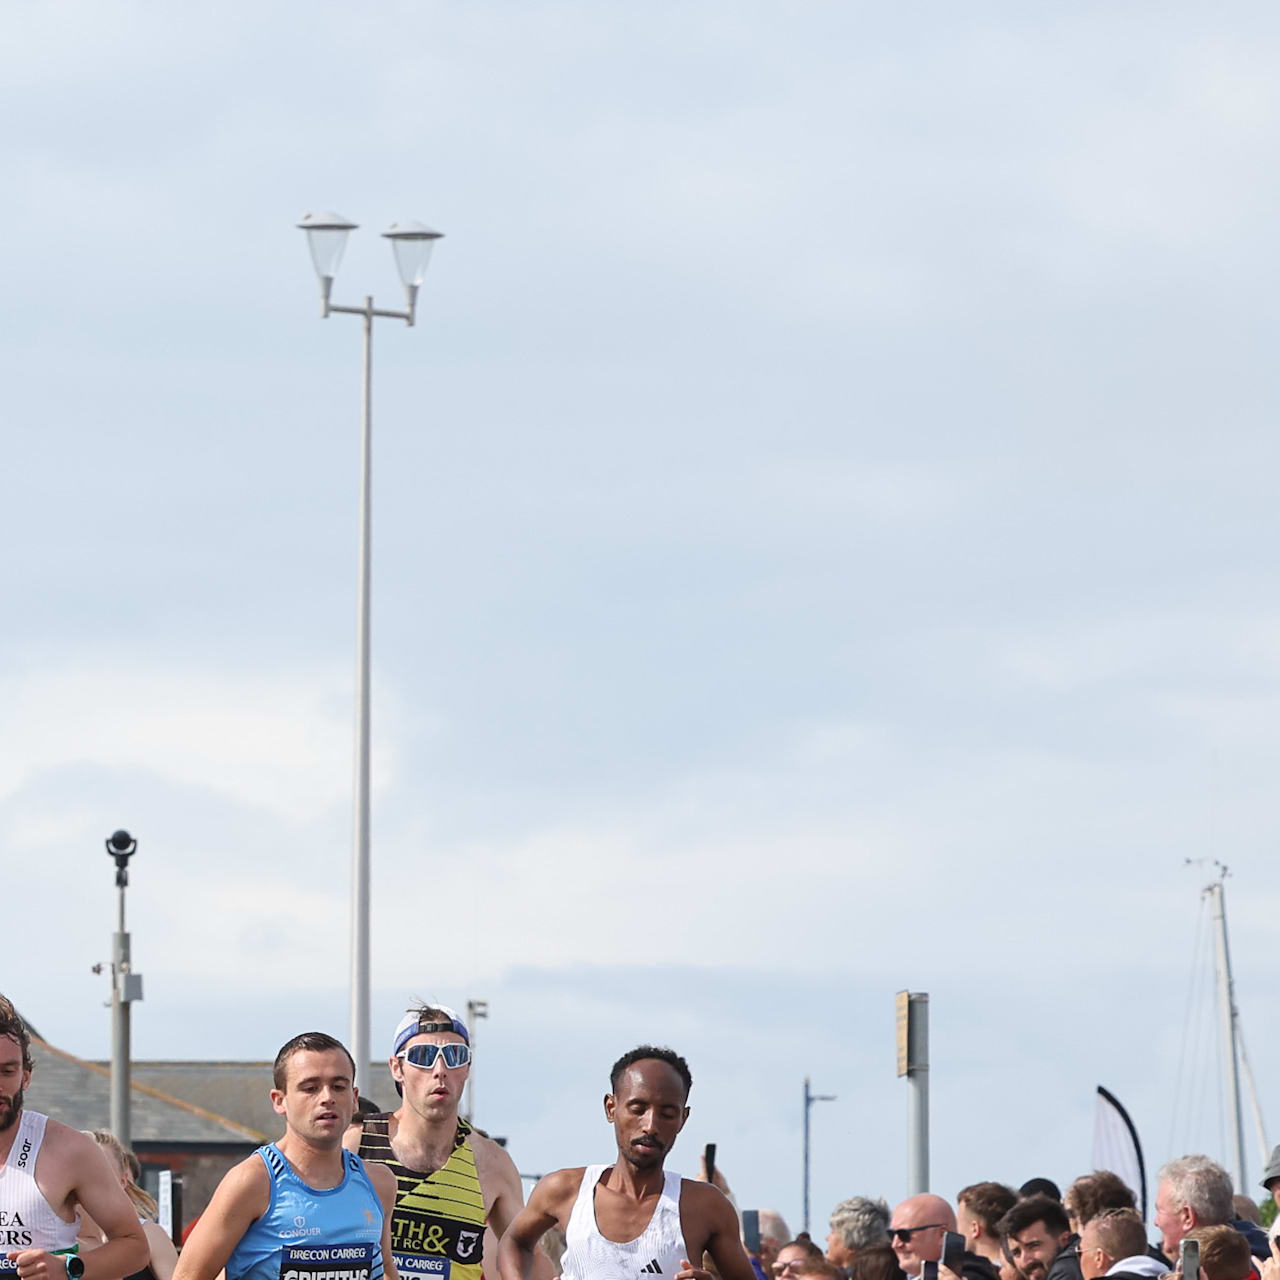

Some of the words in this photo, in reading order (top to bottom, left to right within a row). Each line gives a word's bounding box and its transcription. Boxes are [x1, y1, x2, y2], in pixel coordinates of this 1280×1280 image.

[17, 1138, 32, 1168] soar
[279, 1228, 321, 1239] CONQUER
[289, 1250, 330, 1261] BRECON
[330, 1247, 367, 1260] CARREG
[405, 1258, 444, 1271] CARREG
